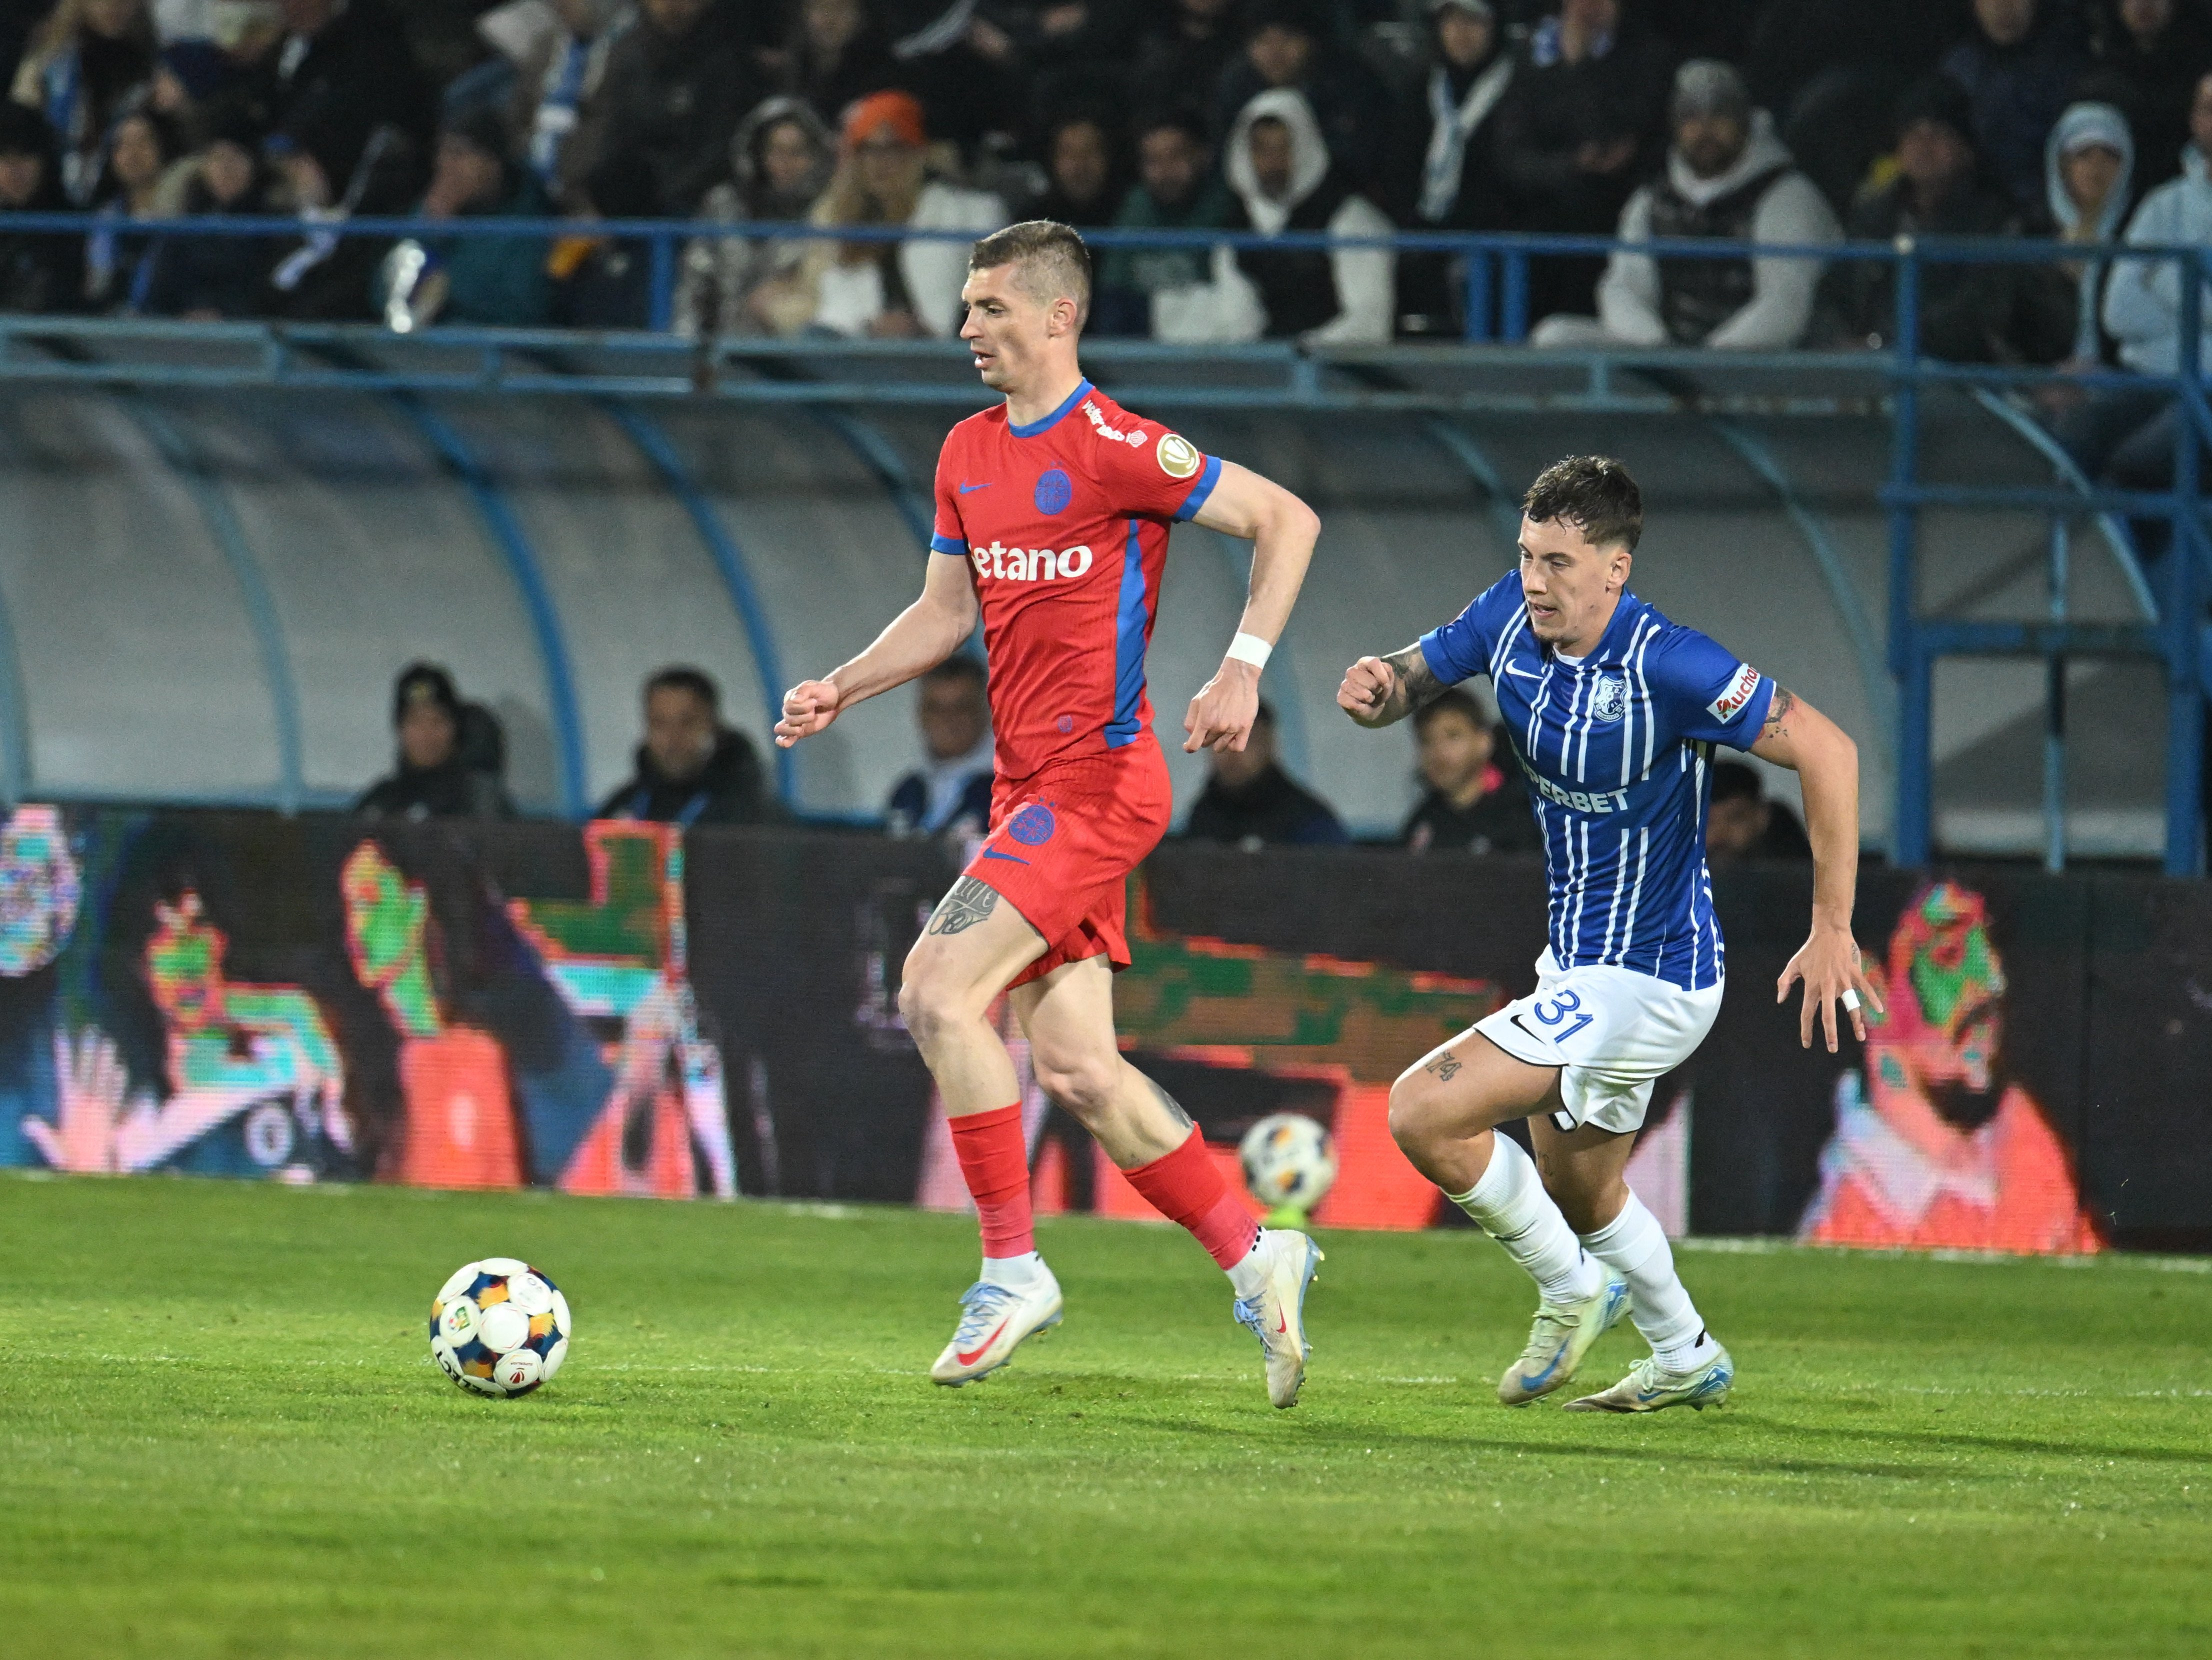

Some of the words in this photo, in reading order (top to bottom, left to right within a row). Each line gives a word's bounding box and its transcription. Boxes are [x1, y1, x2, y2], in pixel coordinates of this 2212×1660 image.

[968, 541, 1093, 581] etano
[1716, 666, 1758, 720] Aucha
[1534, 989, 1594, 1044] 31
